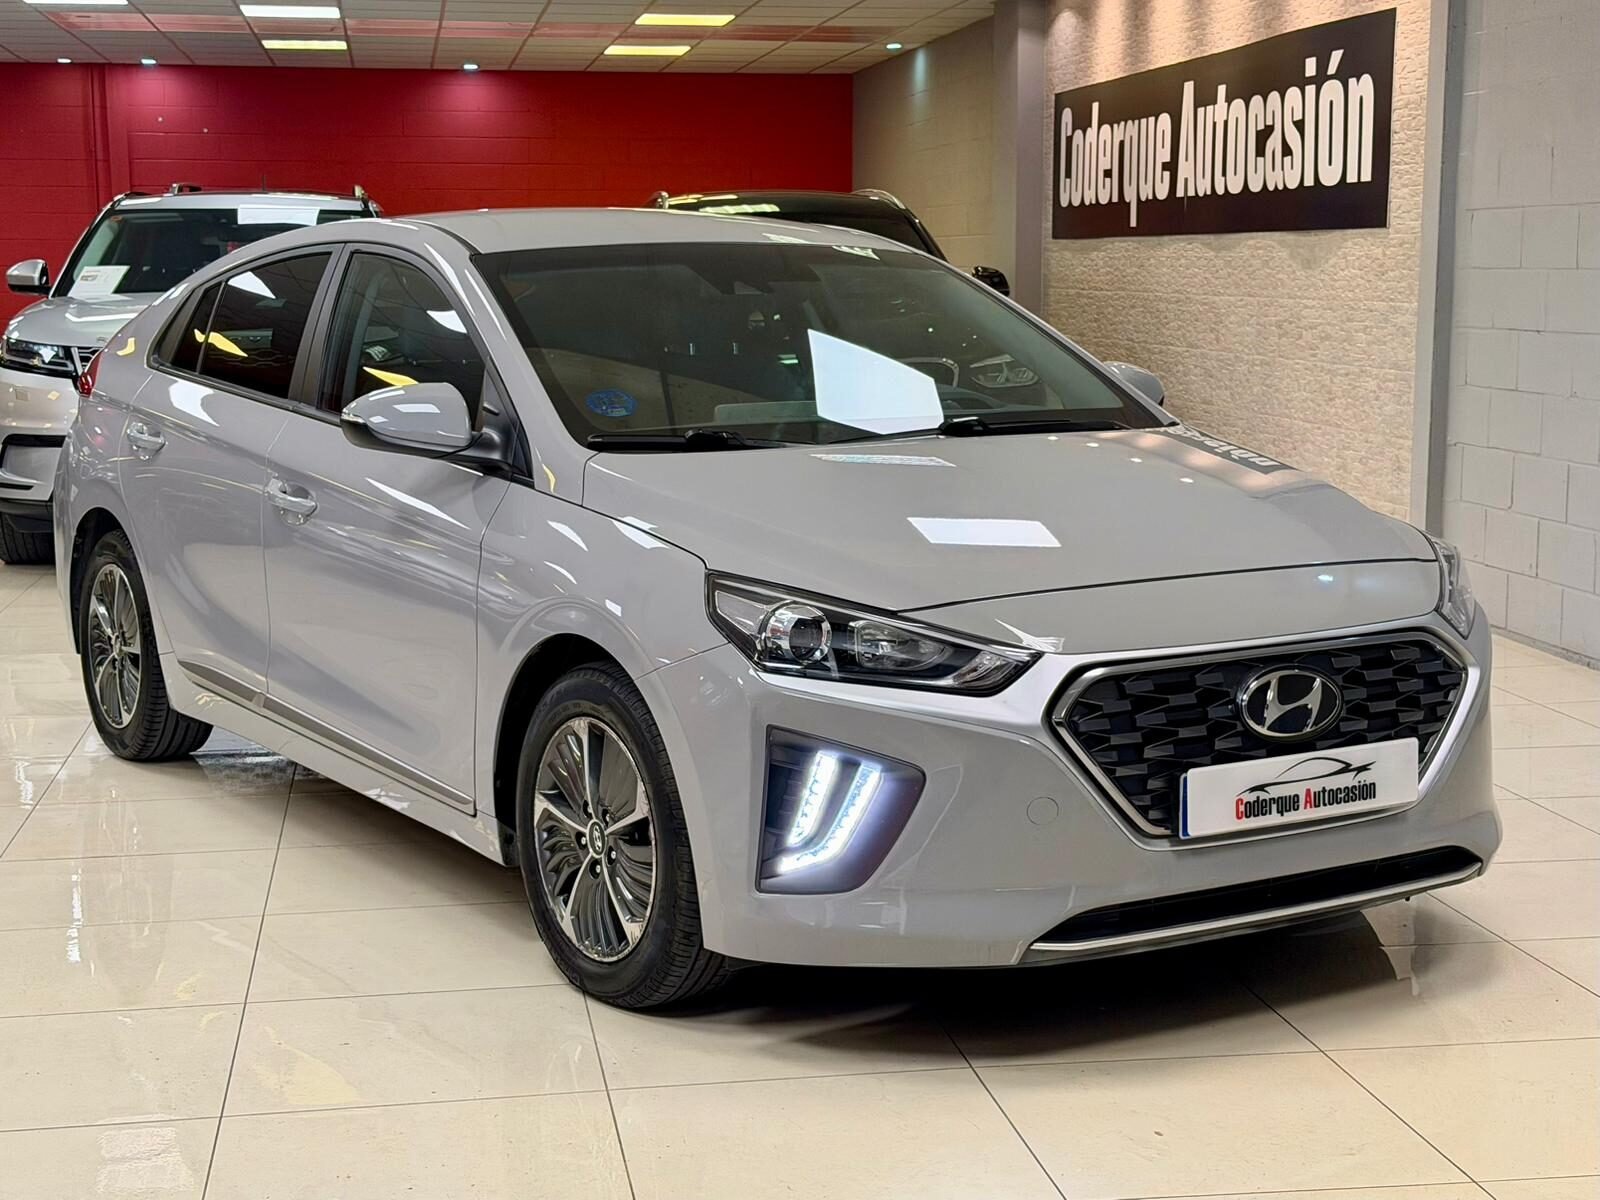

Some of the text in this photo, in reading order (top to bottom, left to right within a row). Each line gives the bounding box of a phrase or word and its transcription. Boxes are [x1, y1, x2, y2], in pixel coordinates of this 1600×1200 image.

[1059, 49, 1375, 228] Coderque Autocasión
[1235, 779, 1377, 820] Coderque Autocasión
